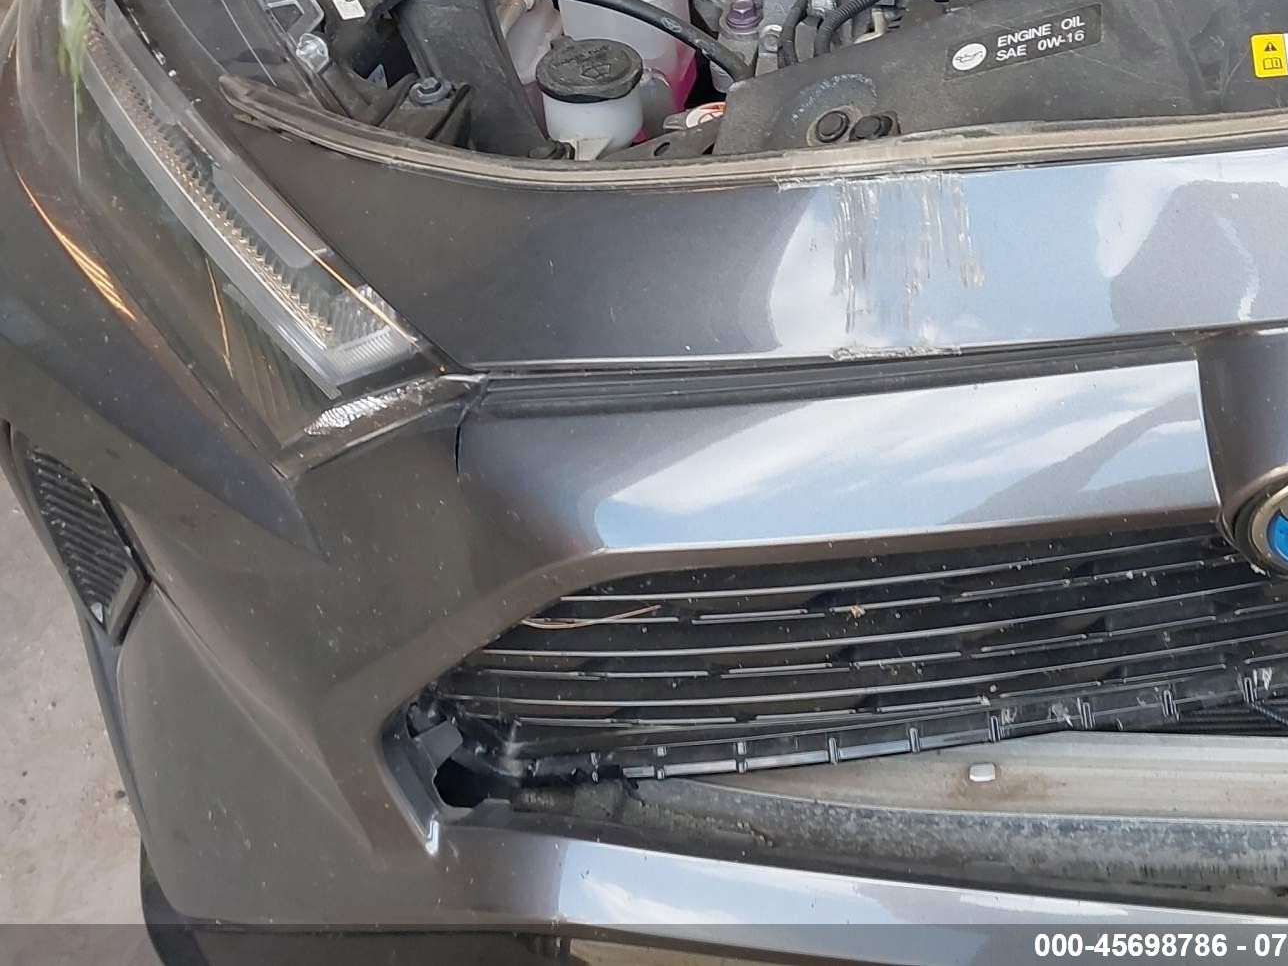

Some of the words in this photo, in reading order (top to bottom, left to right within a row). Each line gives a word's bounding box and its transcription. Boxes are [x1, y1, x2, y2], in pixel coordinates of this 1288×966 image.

[996, 44, 1027, 61] SAE
[1037, 30, 1085, 51] 0W-16
[997, 23, 1052, 47] ENGINE
[1060, 15, 1085, 30] OIL
